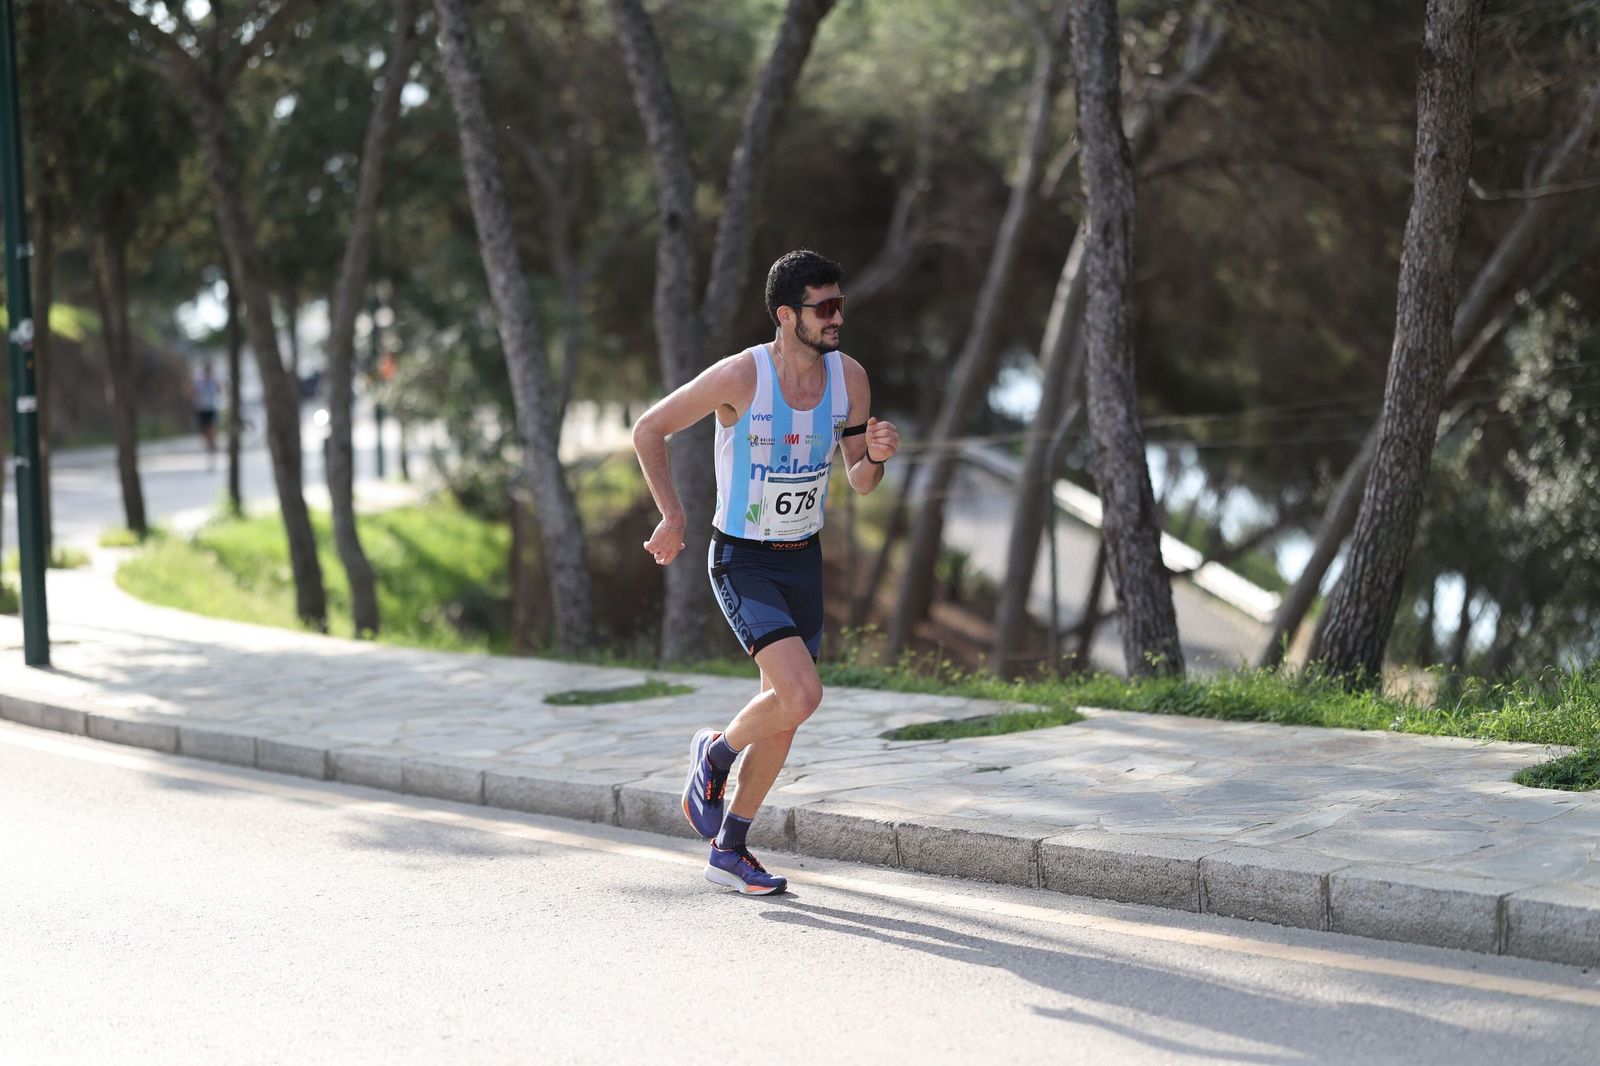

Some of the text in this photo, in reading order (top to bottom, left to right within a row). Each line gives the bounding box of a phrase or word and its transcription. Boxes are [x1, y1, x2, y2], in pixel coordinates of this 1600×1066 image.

[752, 413, 773, 422] vive
[750, 455, 831, 481] mála
[775, 487, 818, 515] 678
[719, 584, 750, 641] WONG
